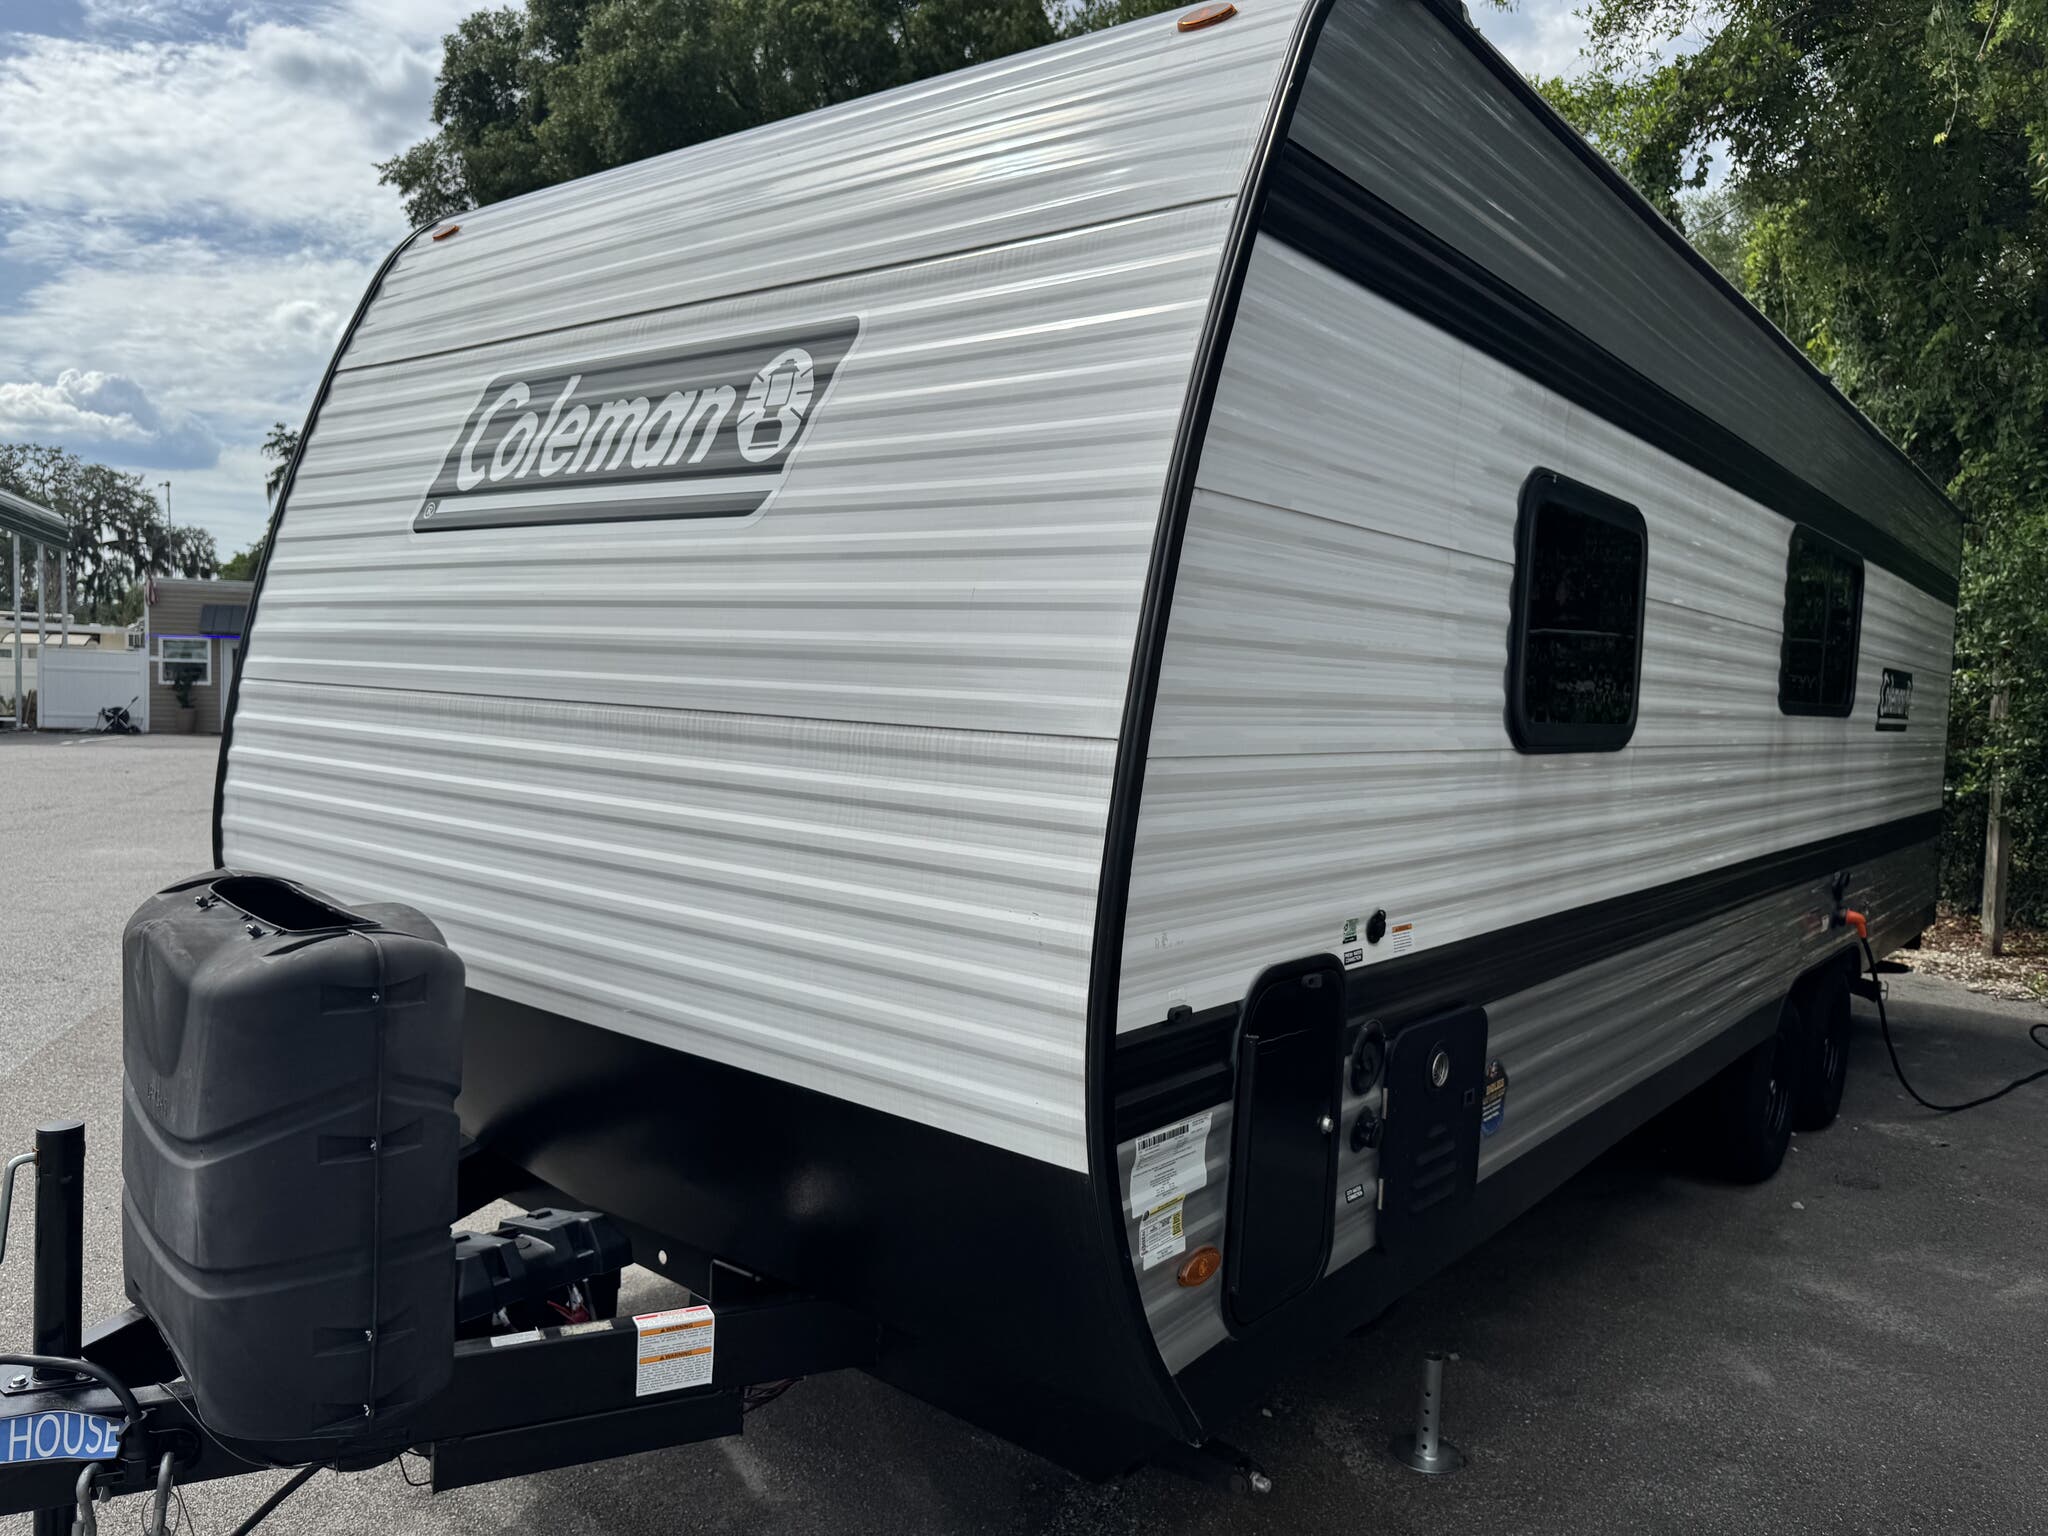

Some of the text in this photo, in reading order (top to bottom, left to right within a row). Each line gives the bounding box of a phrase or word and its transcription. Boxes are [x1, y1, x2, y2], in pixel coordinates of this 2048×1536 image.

[456, 375, 736, 492] Coleman
[665, 1351, 692, 1360] WARNING
[8, 1413, 120, 1461] HOUSE
